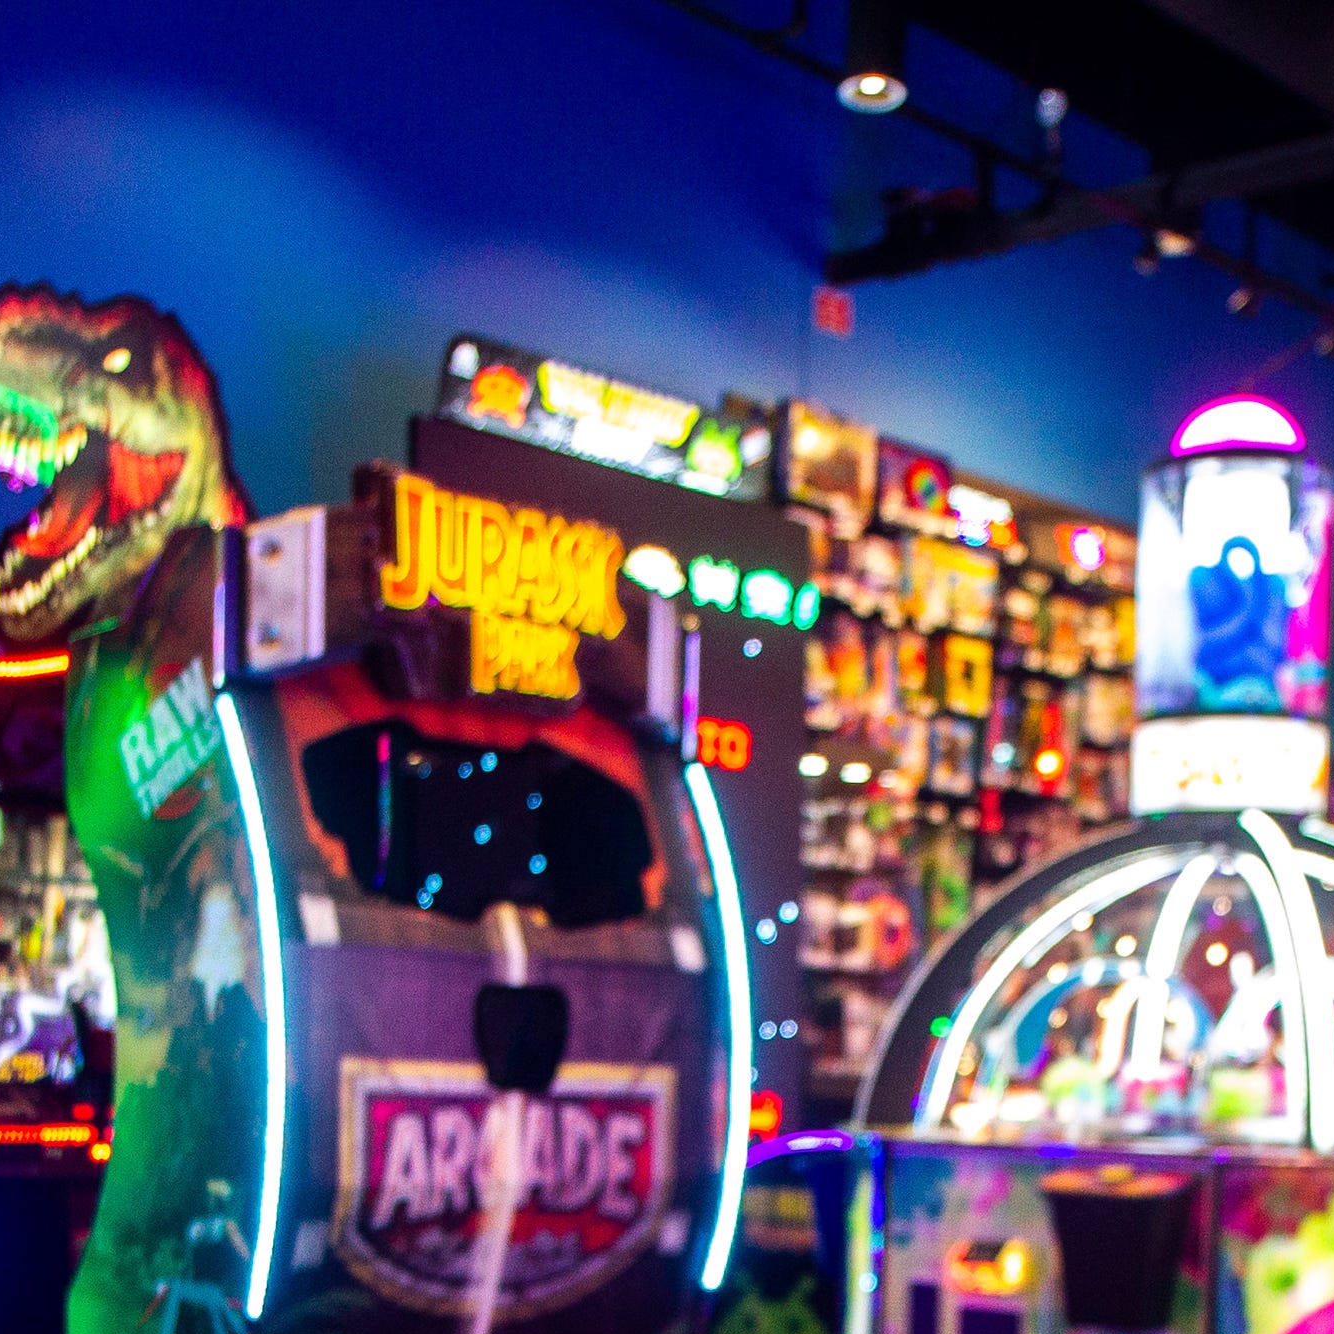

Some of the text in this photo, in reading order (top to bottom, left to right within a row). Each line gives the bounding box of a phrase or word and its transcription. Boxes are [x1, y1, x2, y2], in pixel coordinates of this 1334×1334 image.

[380, 474, 627, 640] JURASSIC
[120, 656, 211, 786] RAW
[470, 612, 581, 701] PARK
